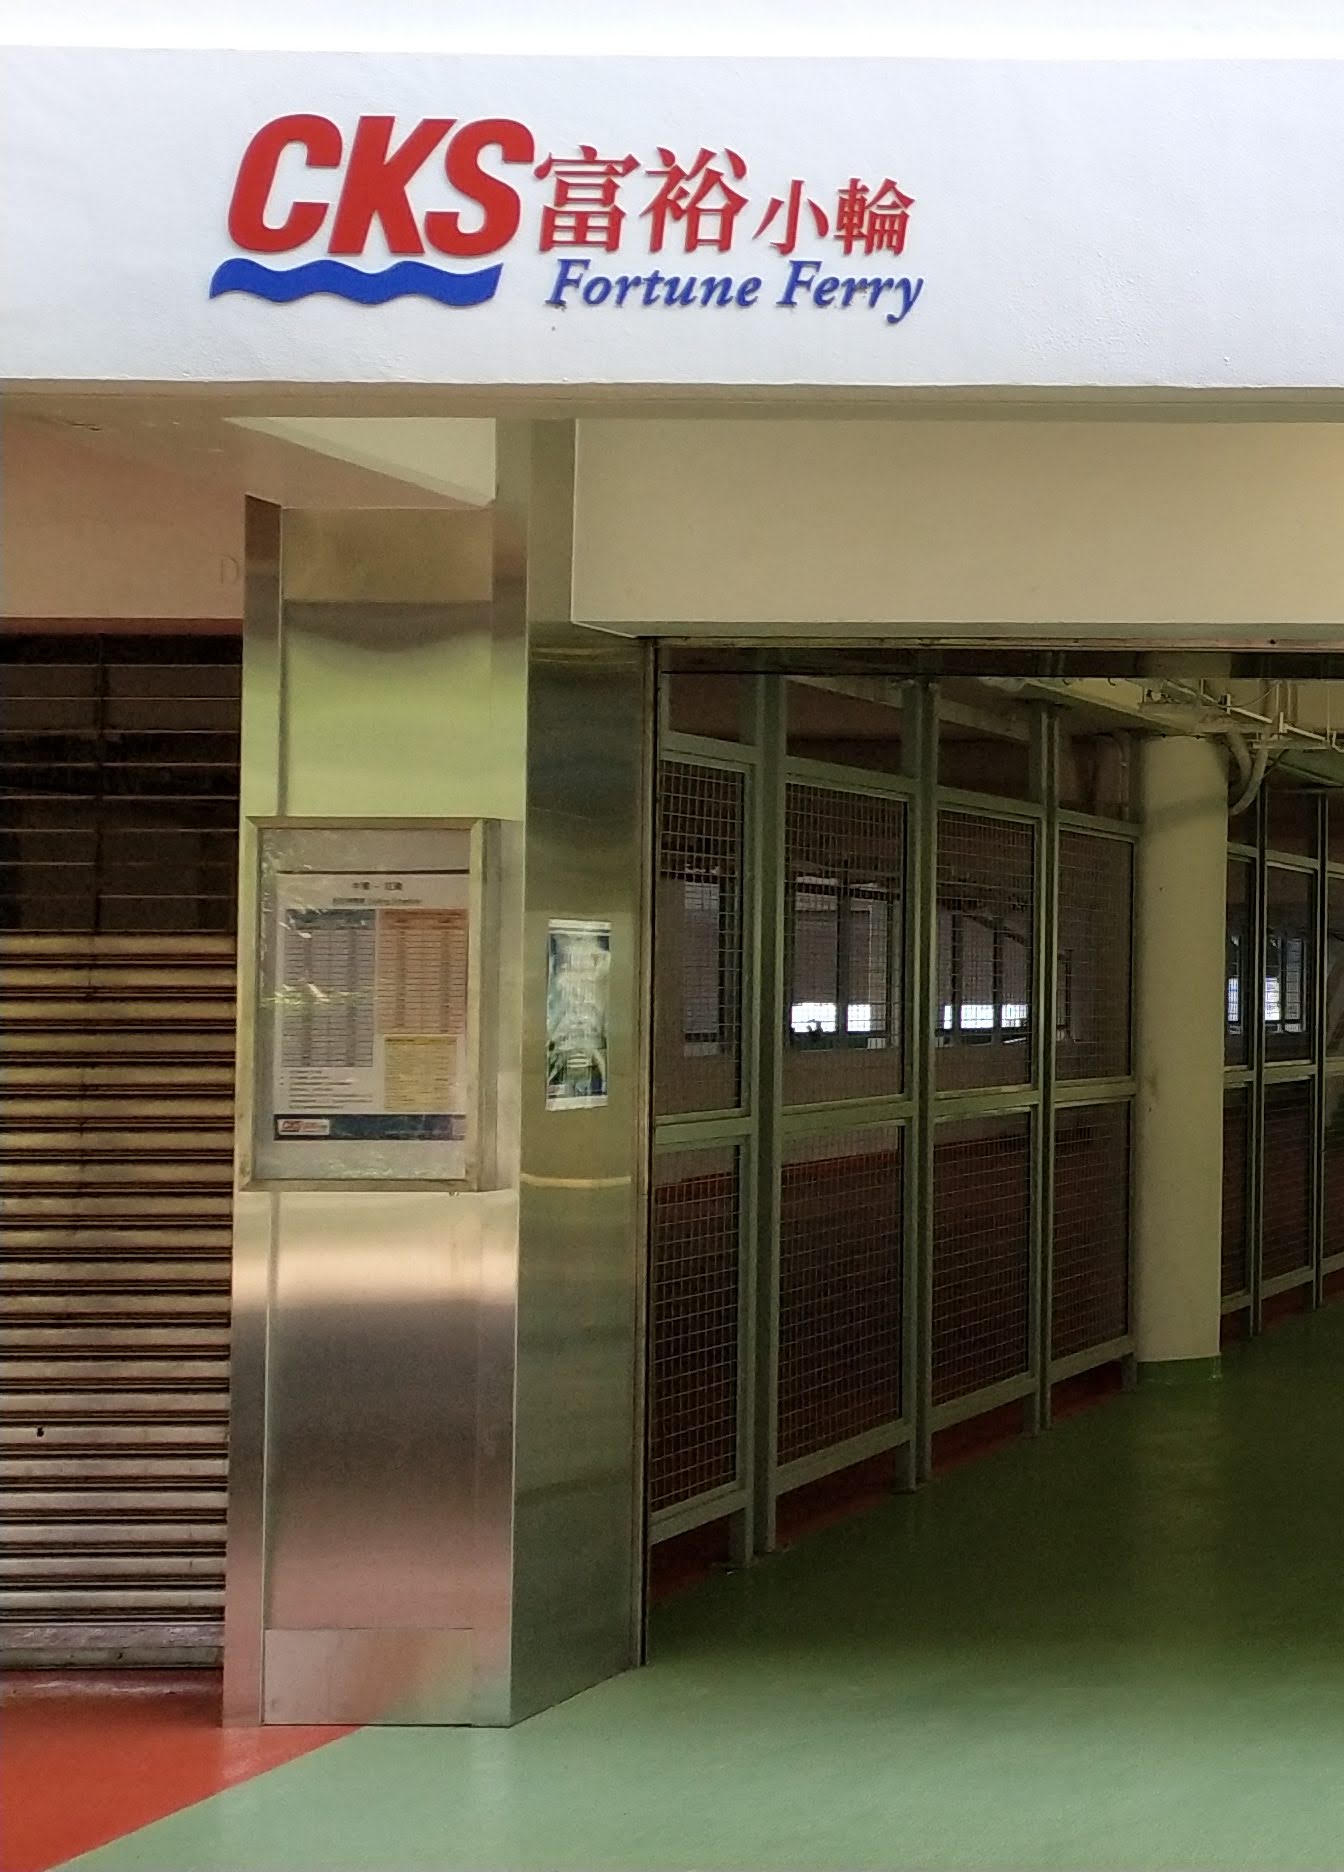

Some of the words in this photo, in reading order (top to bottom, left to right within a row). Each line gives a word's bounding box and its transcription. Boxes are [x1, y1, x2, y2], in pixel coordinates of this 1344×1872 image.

[229, 113, 535, 256] CKS
[545, 258, 759, 308] Fortune
[777, 258, 924, 324] Ferry
